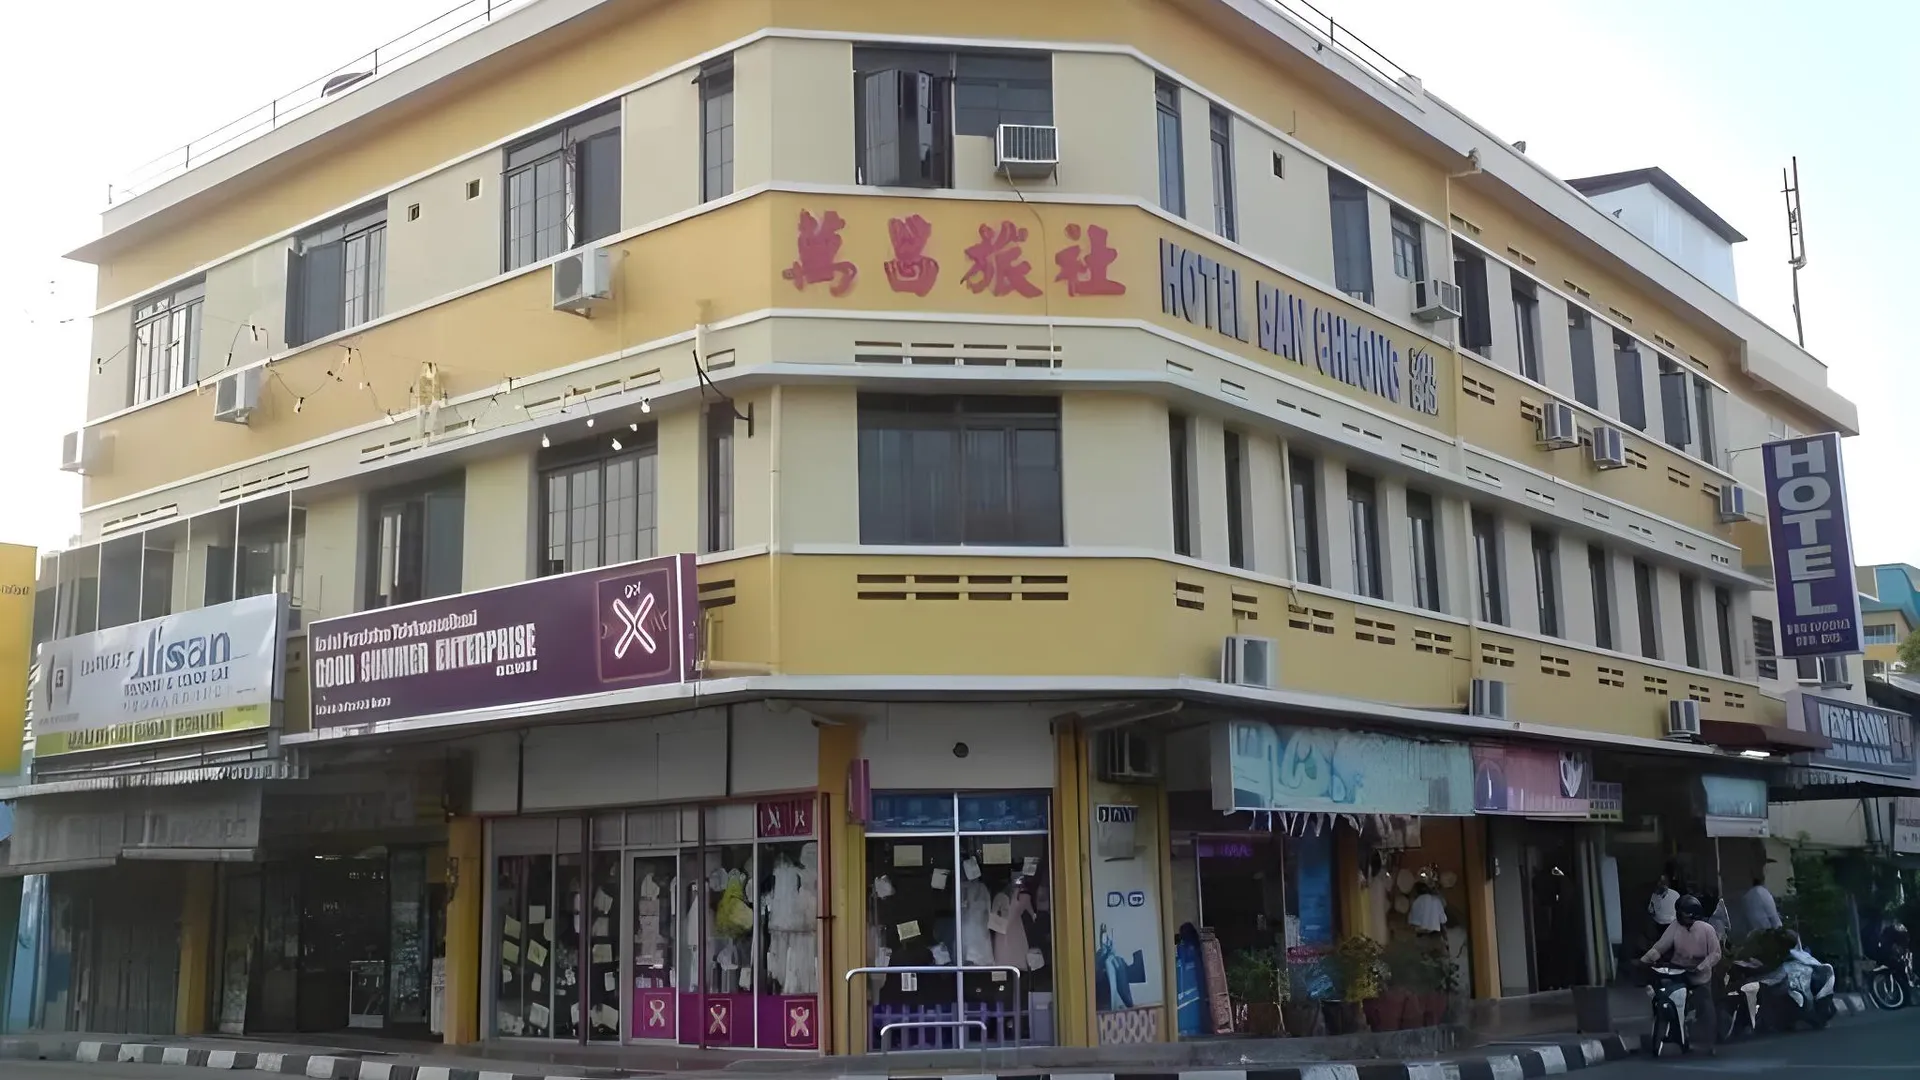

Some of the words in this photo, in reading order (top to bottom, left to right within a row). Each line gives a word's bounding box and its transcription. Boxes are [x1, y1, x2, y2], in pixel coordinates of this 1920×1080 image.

[1160, 238, 1249, 343] HOTEL
[1256, 280, 1306, 366] BAN
[1774, 440, 1838, 616] HOTEL
